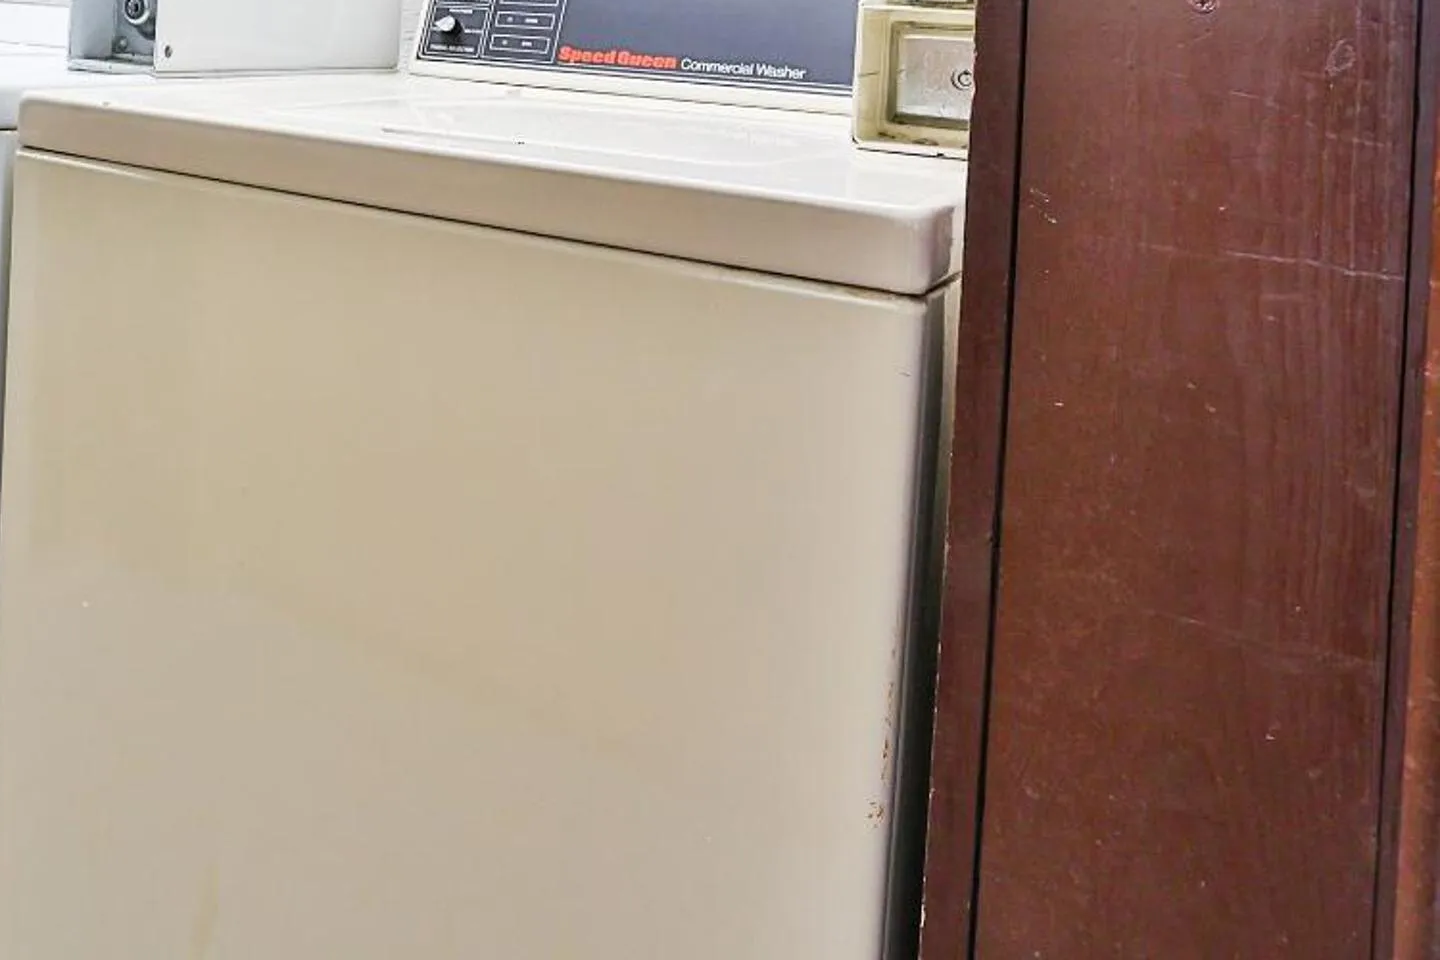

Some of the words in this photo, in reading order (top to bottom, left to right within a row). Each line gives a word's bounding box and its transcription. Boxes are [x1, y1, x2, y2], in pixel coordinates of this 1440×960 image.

[558, 45, 616, 65] Speed
[617, 50, 677, 69] Queen
[680, 57, 754, 77] Commercial
[755, 62, 807, 80] Washer
